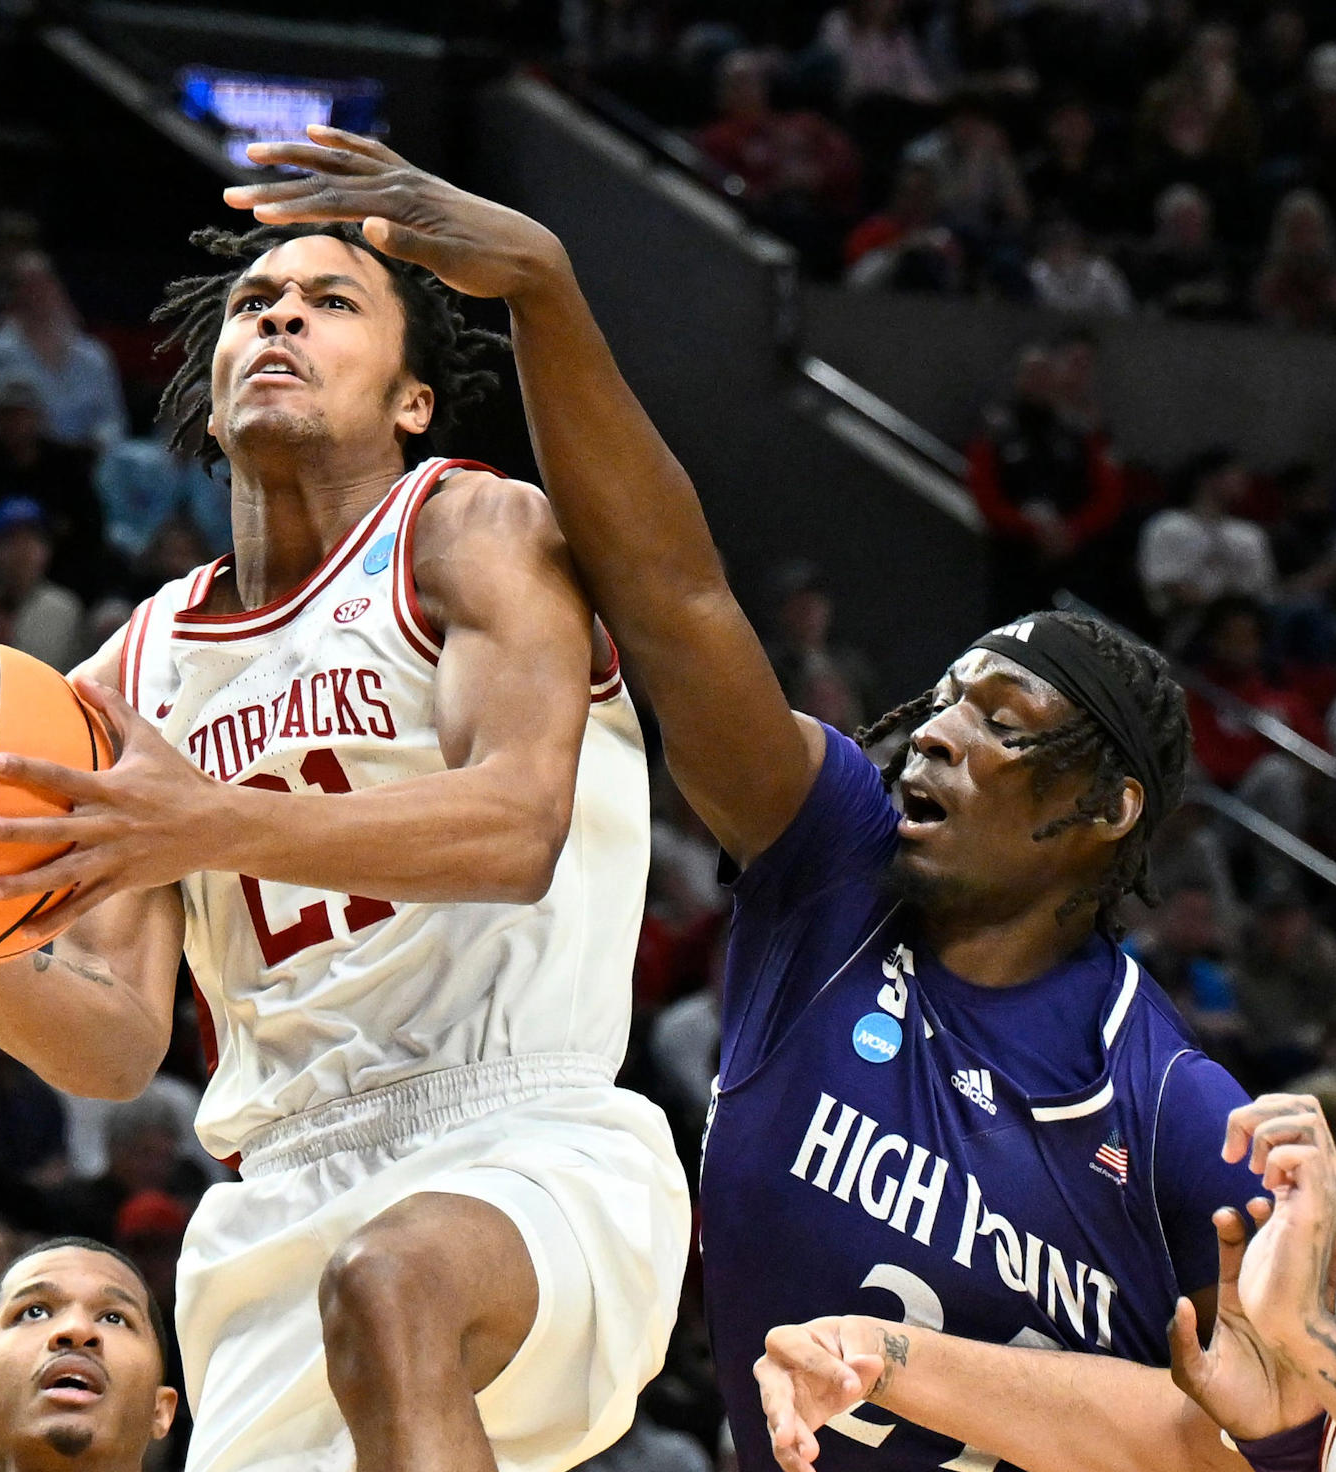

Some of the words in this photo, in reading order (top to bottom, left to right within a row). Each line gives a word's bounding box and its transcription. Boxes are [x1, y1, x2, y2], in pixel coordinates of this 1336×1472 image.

[188, 667, 397, 784] ZORACKS
[857, 1029, 898, 1058] NCAA
[950, 1073, 998, 1116] adidas
[790, 1092, 949, 1247] HIGH
